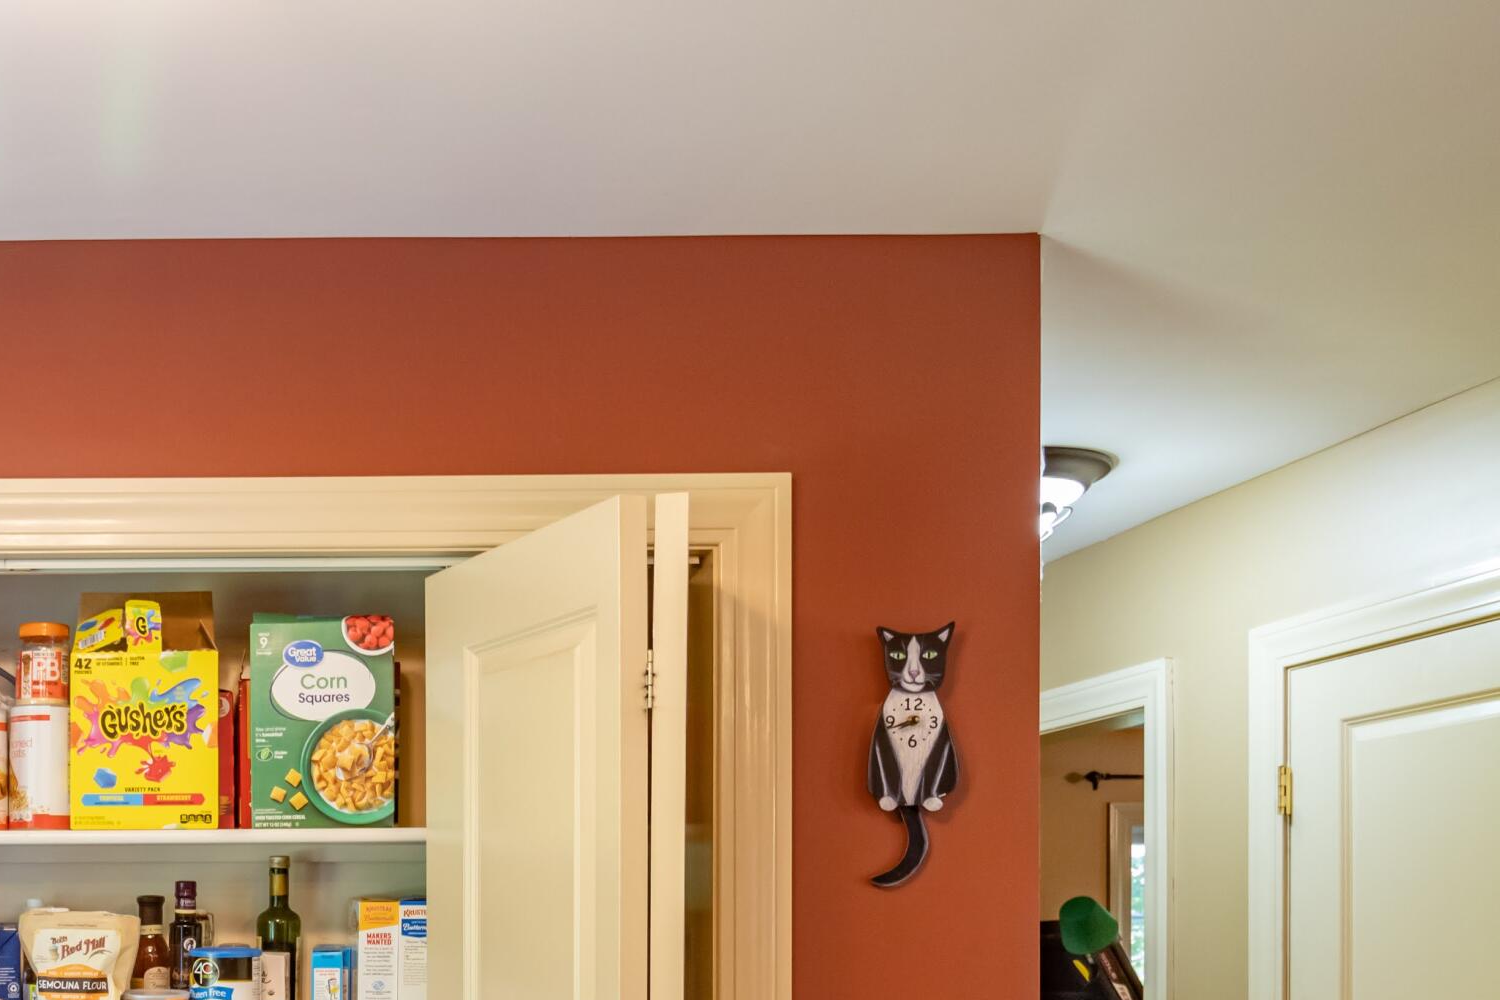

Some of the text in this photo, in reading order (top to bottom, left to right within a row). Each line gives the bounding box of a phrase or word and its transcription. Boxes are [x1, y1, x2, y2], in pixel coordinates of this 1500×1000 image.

[136, 616, 148, 635] G
[260, 637, 268, 648] 9
[288, 646, 317, 656] Great
[74, 658, 92, 669] 42
[300, 673, 348, 690] Corn
[298, 692, 350, 706] Squares
[905, 698, 923, 711] 12
[100, 702, 186, 739] Gushers
[885, 715, 896, 729] 9
[929, 716, 938, 729] 3
[908, 734, 918, 748] 6
[60, 941, 82, 960] Red
[83, 936, 106, 956] Mill
[194, 962, 213, 984] 4C
[38, 980, 107, 990] SEMOLINA FLOUR
[208, 987, 227, 998] Free
